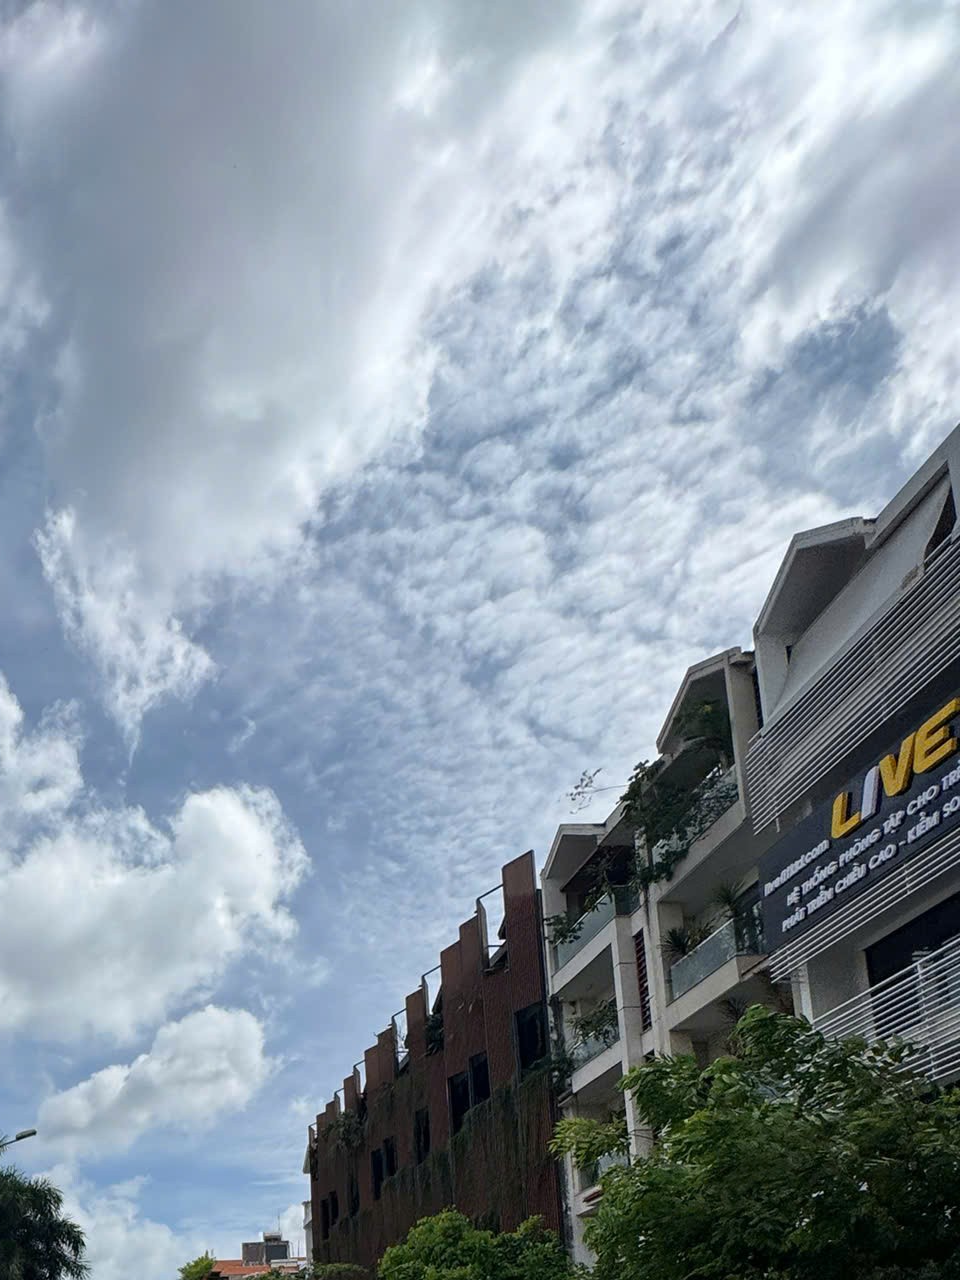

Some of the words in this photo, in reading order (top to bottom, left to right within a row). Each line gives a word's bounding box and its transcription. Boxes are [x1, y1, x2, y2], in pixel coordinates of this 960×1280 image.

[831, 697, 960, 838] LIVE
[906, 785, 940, 815] CHO
[868, 843, 898, 869] CAO
